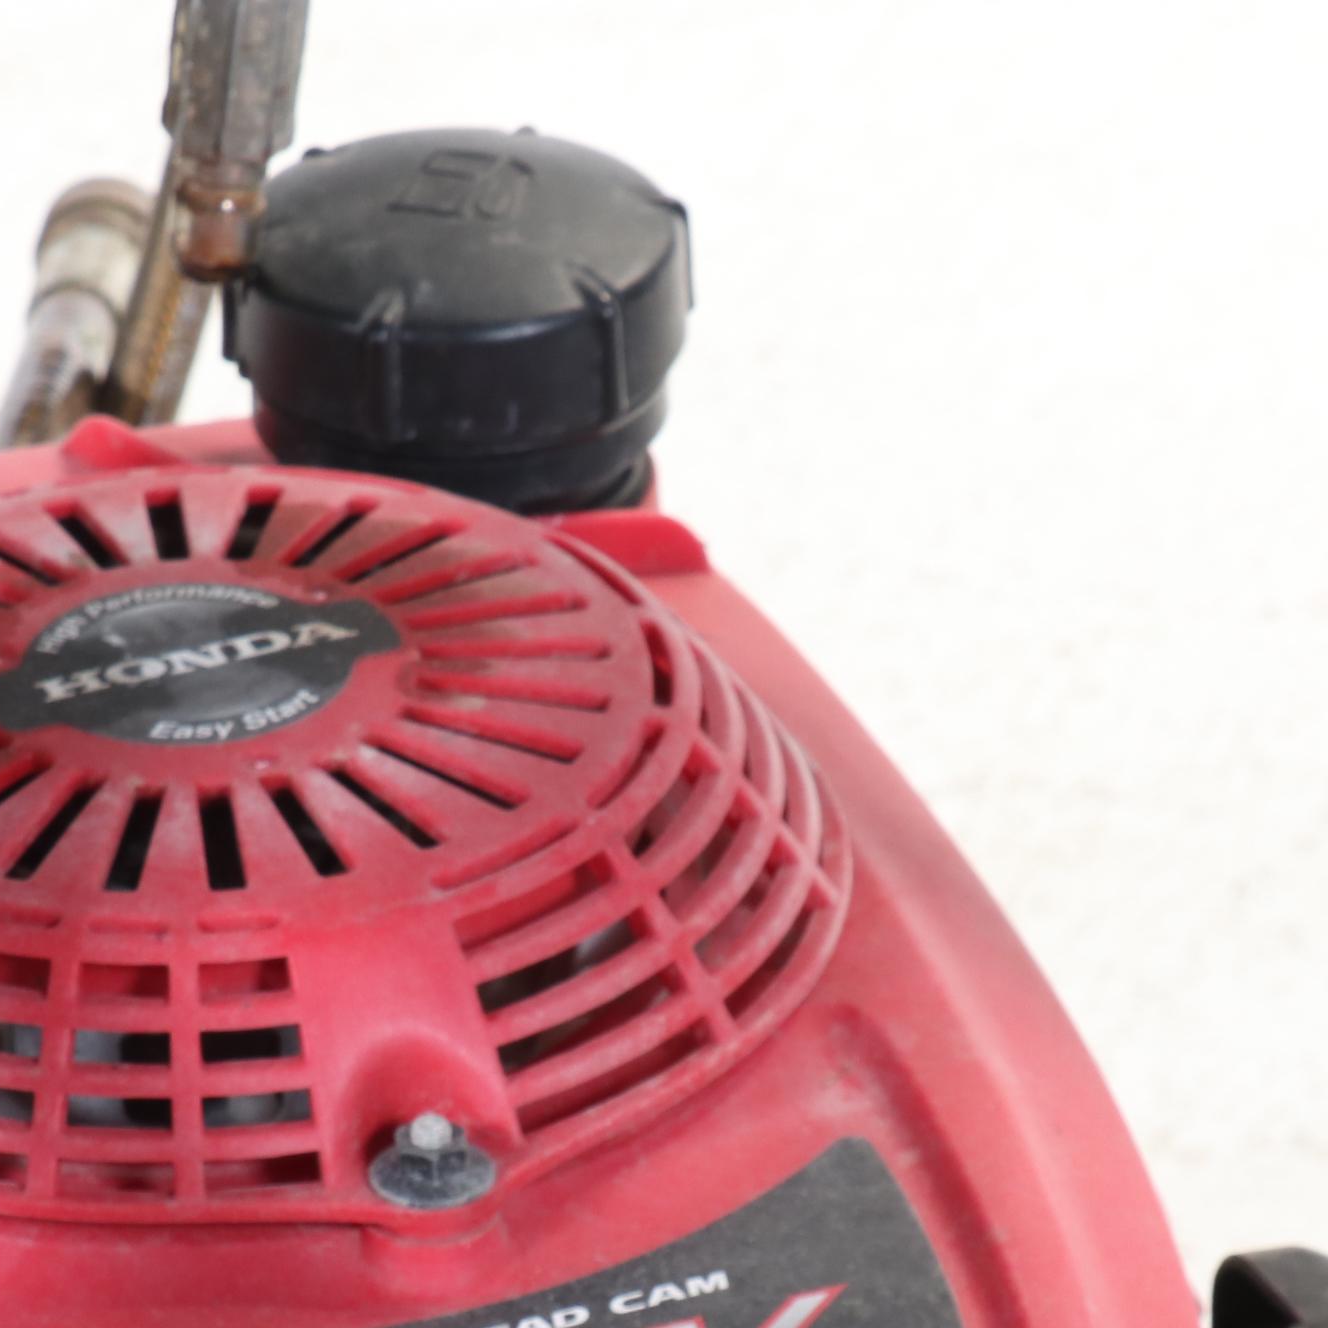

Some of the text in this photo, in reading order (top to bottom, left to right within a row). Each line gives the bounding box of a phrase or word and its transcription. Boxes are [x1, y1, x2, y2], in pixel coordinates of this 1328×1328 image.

[34, 621, 359, 704] HONDA
[148, 687, 320, 744] Easy Start
[609, 1268, 730, 1318] CAM
